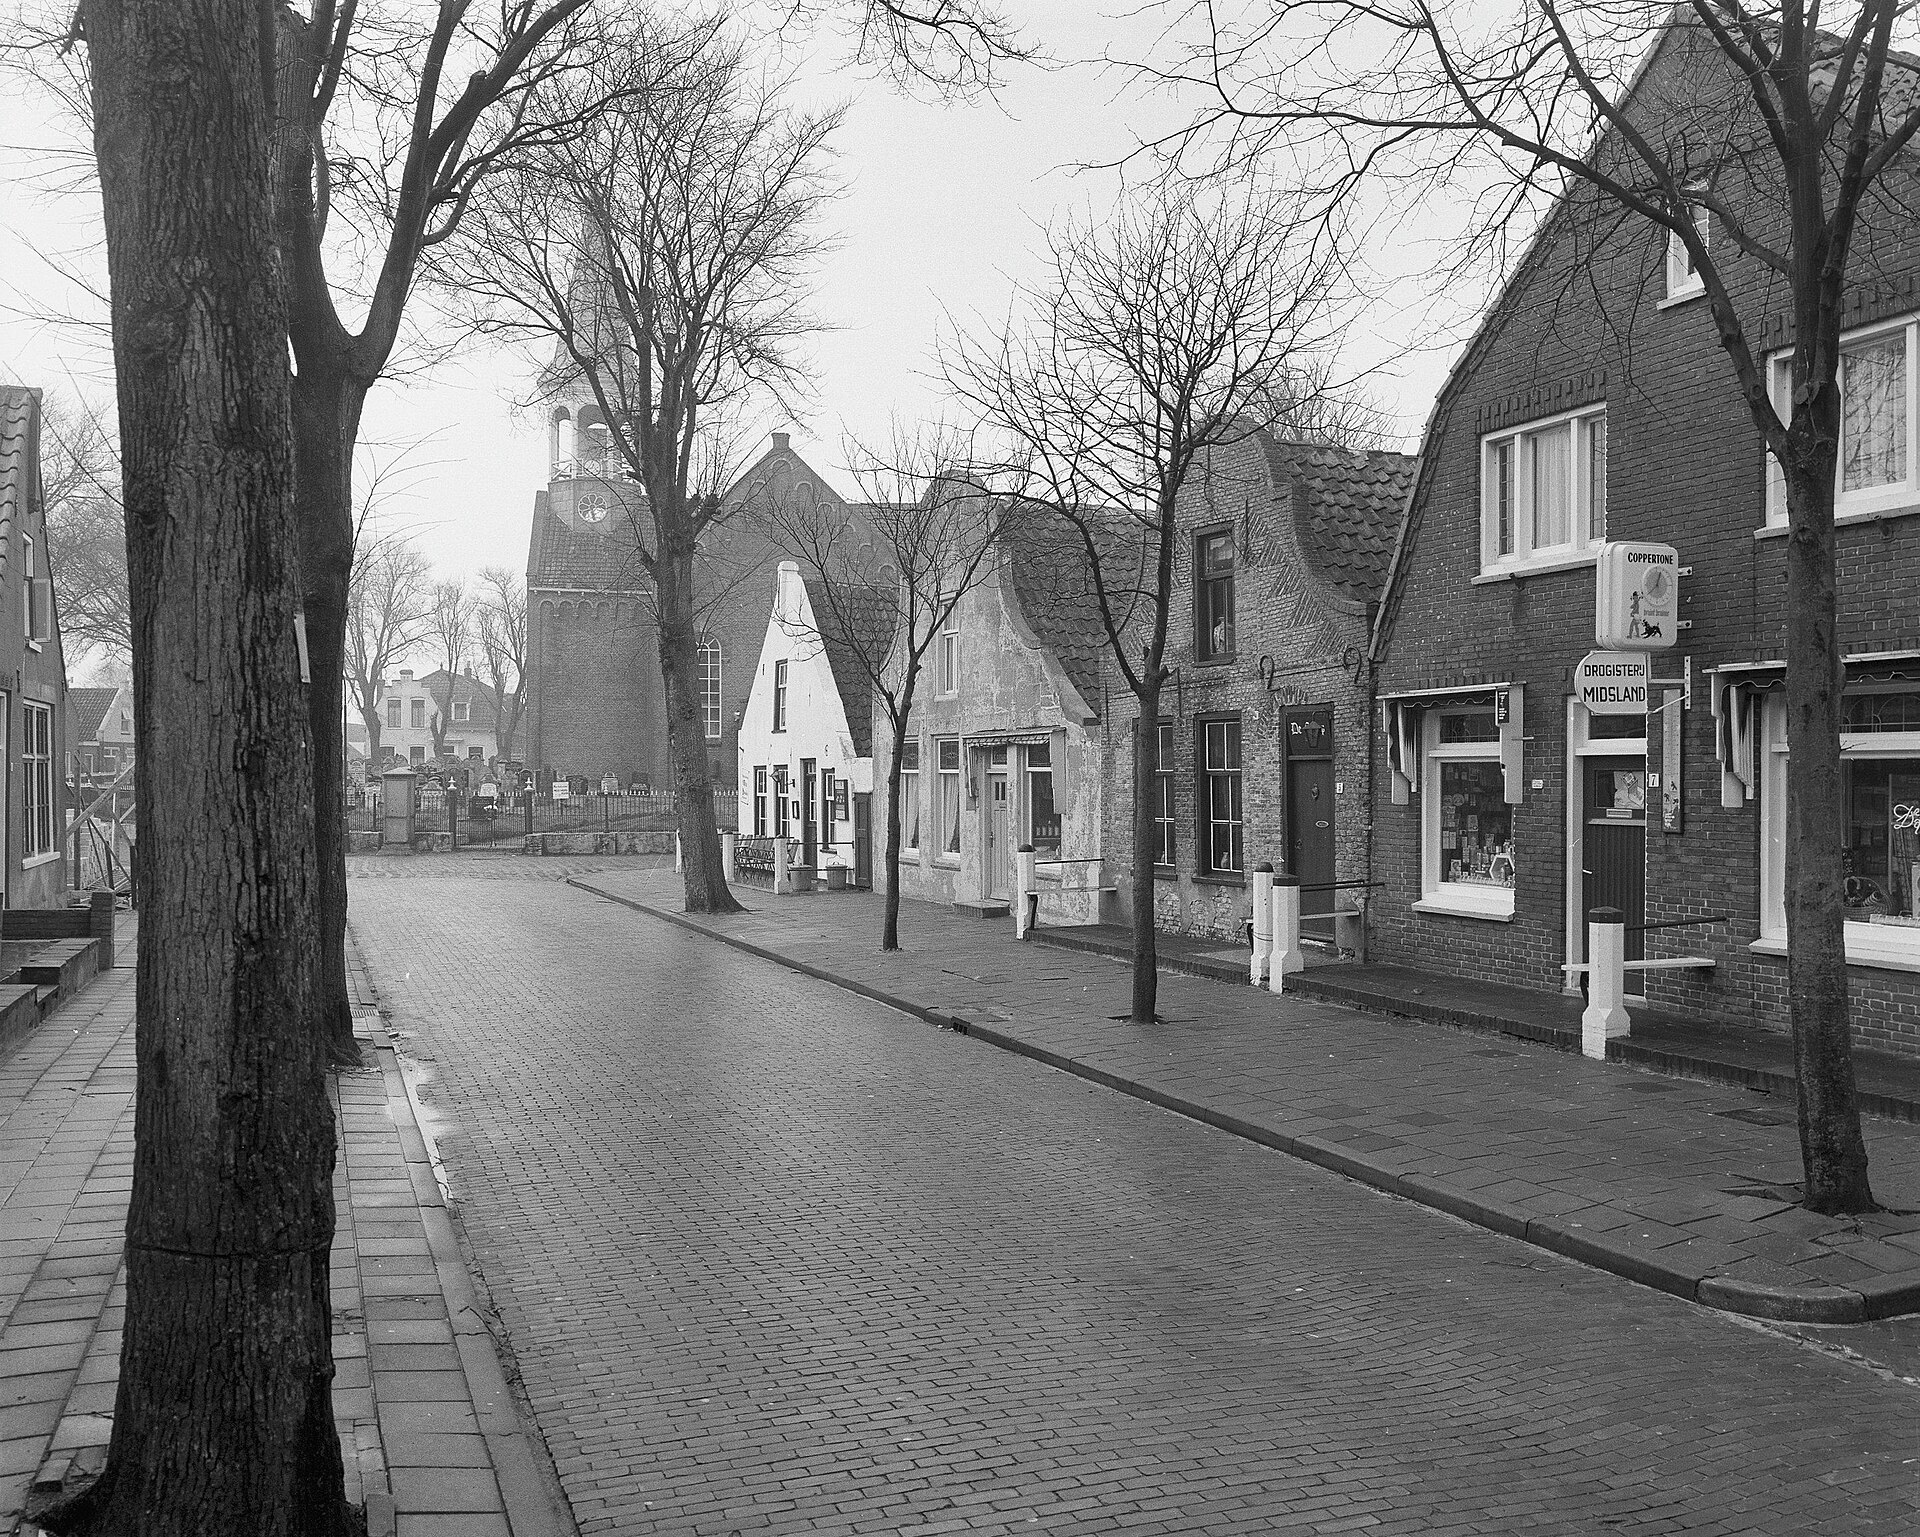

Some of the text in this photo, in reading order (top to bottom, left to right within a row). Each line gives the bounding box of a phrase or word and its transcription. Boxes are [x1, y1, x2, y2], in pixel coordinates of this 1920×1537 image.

[1628, 552, 1673, 565] COPPERTONE
[1583, 687, 1646, 702] MIDSLAND
[1651, 774, 1656, 786] 7
